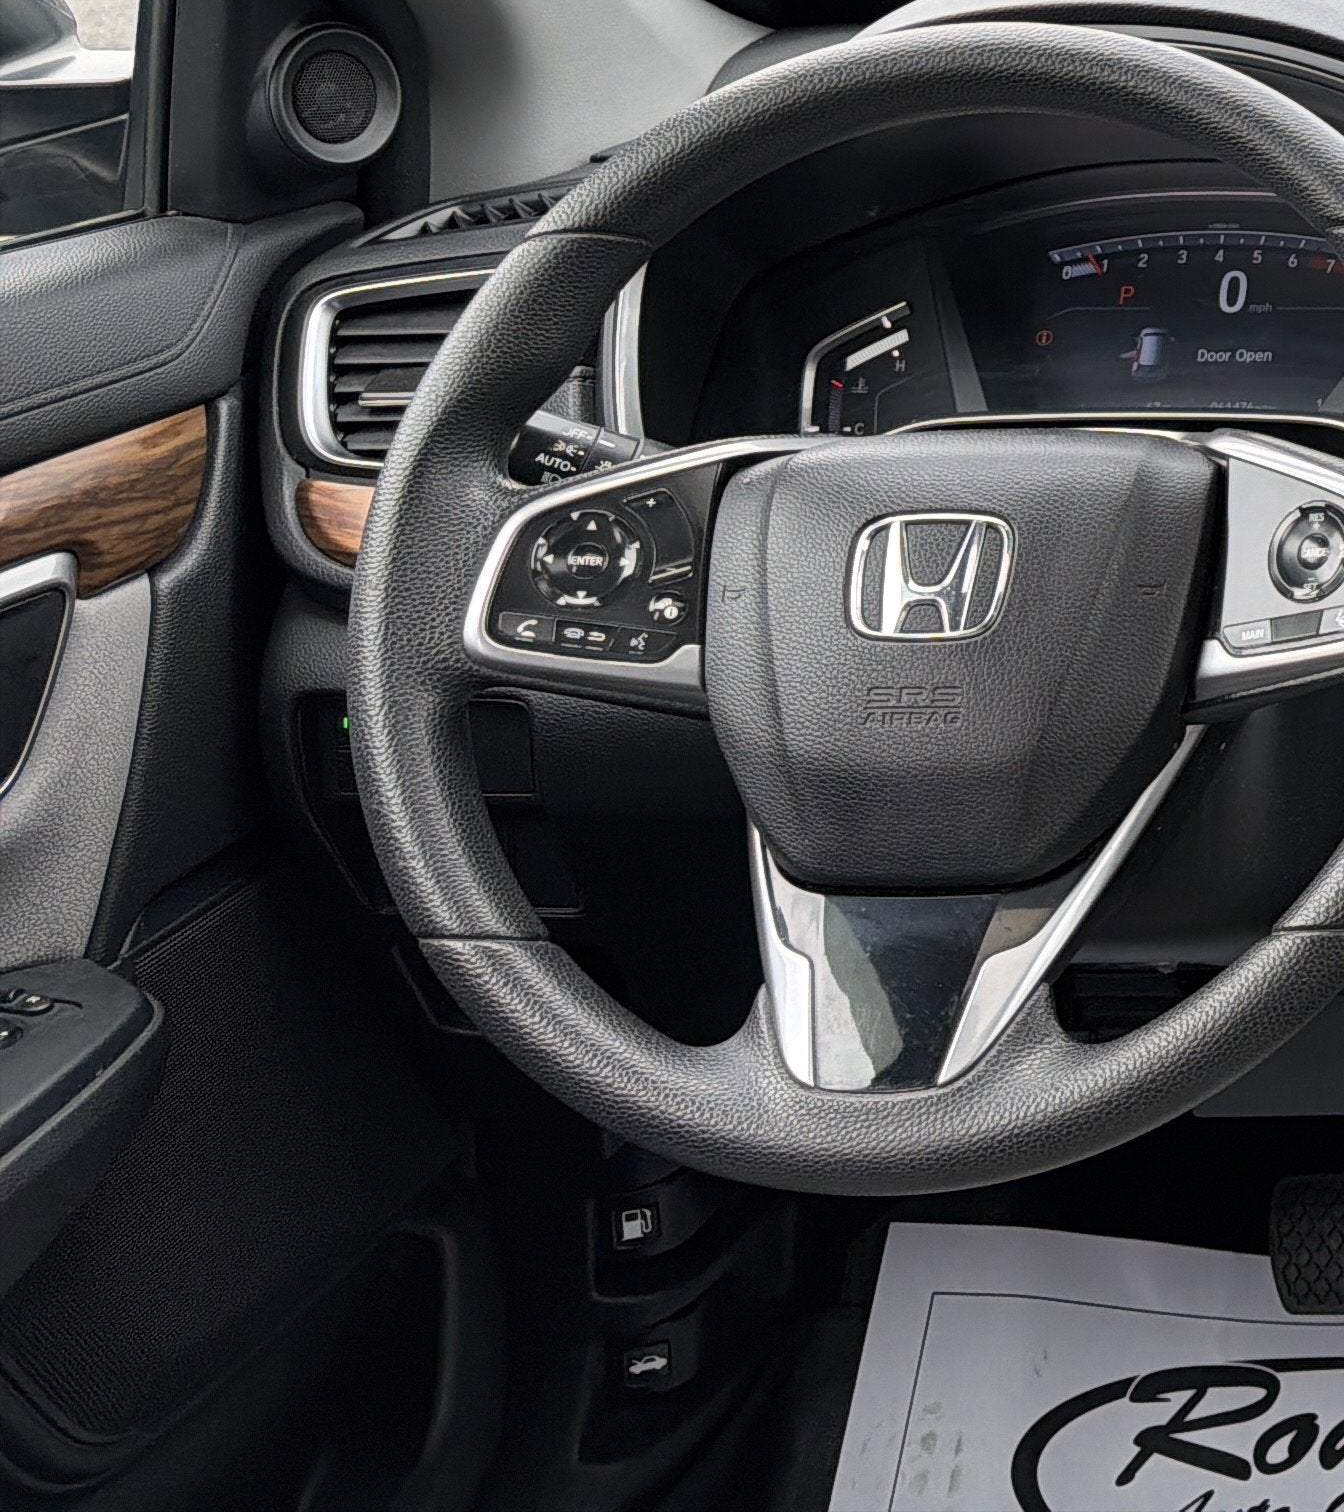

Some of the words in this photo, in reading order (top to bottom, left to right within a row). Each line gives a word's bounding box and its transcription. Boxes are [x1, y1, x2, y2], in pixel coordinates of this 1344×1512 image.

[1137, 253, 1149, 268] 2
[1177, 249, 1188, 264] 3
[1213, 249, 1225, 263] 4
[1252, 249, 1264, 264] 5
[1287, 253, 1299, 268] 6
[1325, 258, 1337, 273] 7
[1118, 286, 1136, 305] P
[1218, 270, 1248, 314] 0
[1248, 302, 1273, 314] mph
[895, 359, 906, 372] H
[1197, 348, 1231, 363] Door
[1235, 349, 1273, 366] Open
[534, 452, 572, 472] AUTO
[1309, 512, 1325, 522] RES
[571, 554, 604, 567] ENTER
[1241, 628, 1265, 641] MAIN
[865, 685, 962, 706] SRS
[859, 711, 962, 726] AIRBAG
